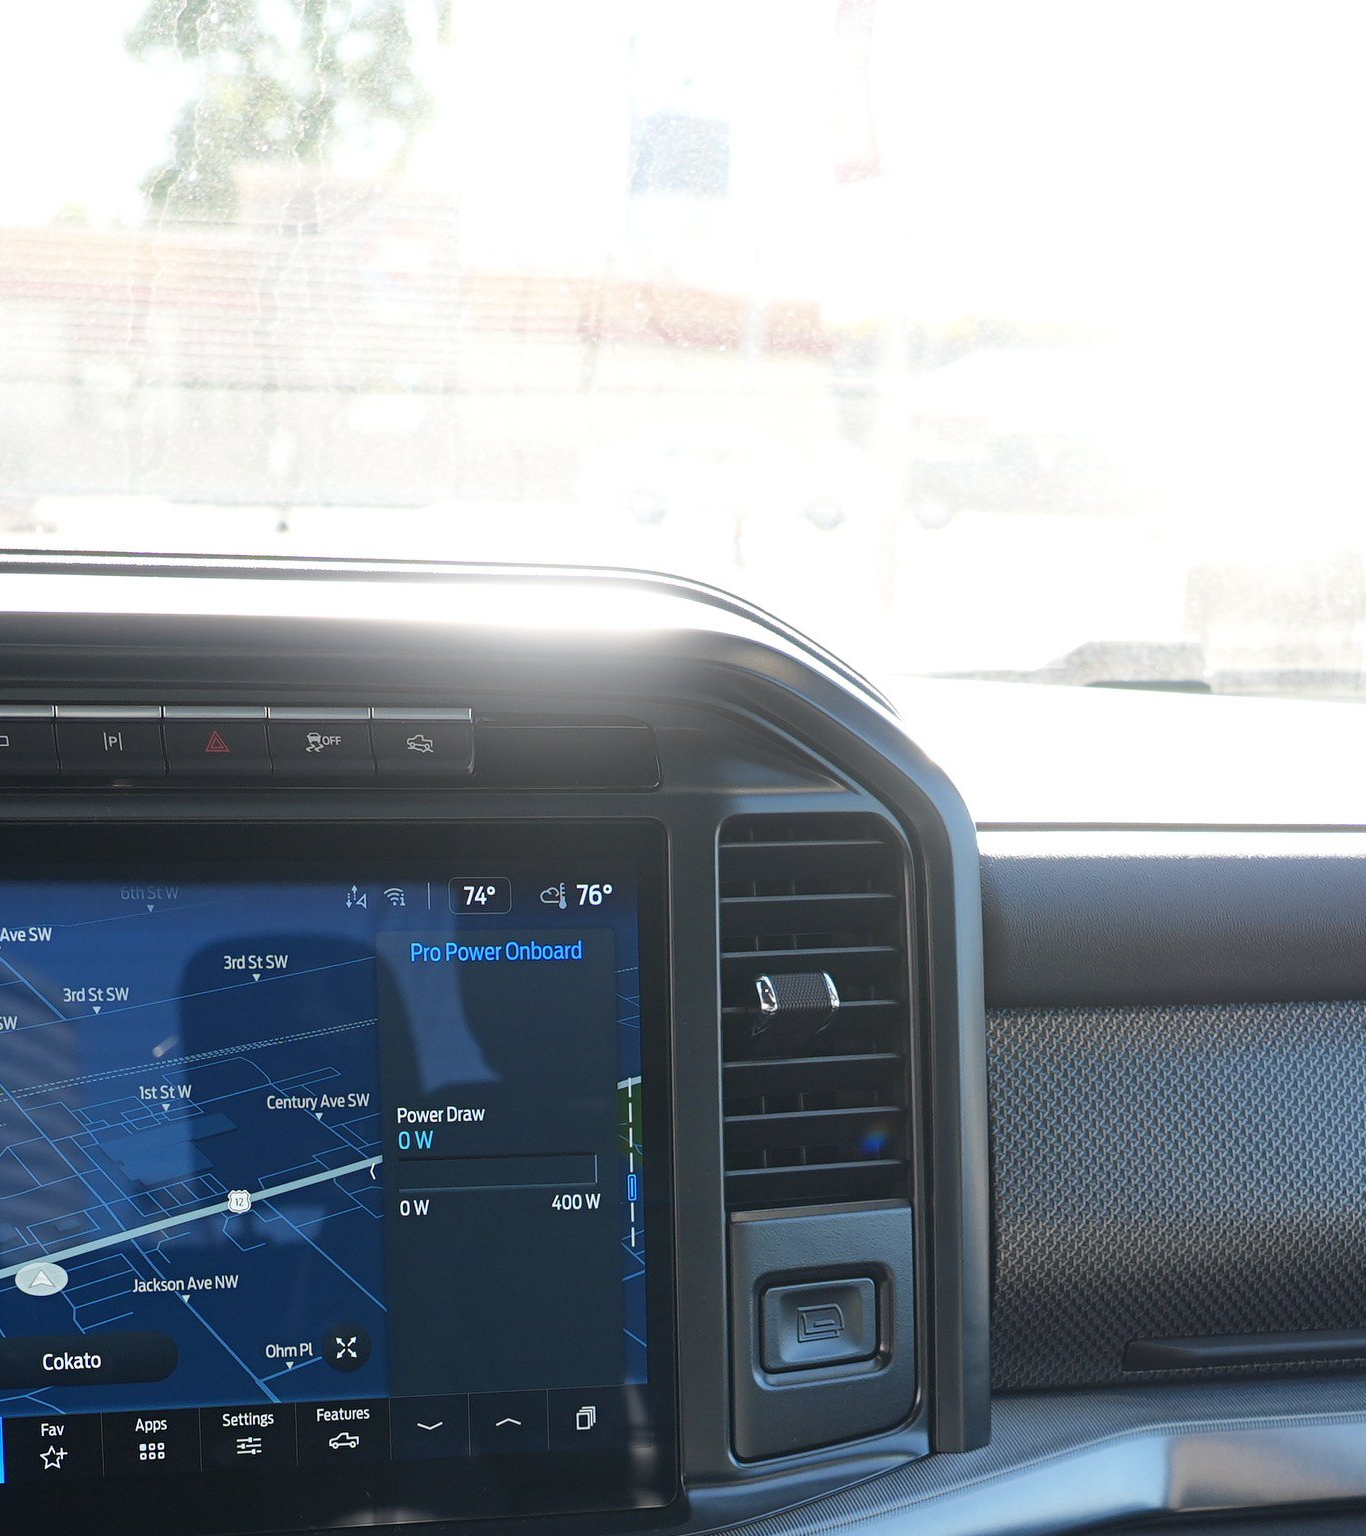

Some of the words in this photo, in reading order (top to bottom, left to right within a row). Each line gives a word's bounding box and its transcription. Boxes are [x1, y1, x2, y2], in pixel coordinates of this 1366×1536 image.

[322, 734, 341, 748] OFF
[121, 887, 144, 900] 6th
[148, 886, 161, 900] St
[166, 887, 178, 899] W
[464, 886, 495, 905] 74°
[577, 884, 612, 906] 76°
[0, 927, 26, 942] Ave
[28, 927, 52, 942] SW
[410, 943, 441, 962] Pro
[446, 942, 501, 962] Power
[506, 941, 583, 960] Onboard
[224, 956, 244, 970] 3rd
[248, 956, 263, 969] St
[266, 955, 288, 969] SW
[63, 988, 84, 1002] 3rd
[87, 988, 103, 1002] St
[105, 988, 129, 1001] SW
[139, 1086, 157, 1100] 1st
[160, 1085, 175, 1099] St
[177, 1085, 192, 1098] W
[266, 1094, 317, 1110] Century
[320, 1094, 345, 1108] Ave
[348, 1093, 370, 1107] SW
[397, 1107, 443, 1123] Power
[447, 1106, 485, 1122] Draw
[398, 1131, 410, 1150] 0
[415, 1130, 433, 1149] W
[235, 1196, 245, 1208] 12
[400, 1201, 410, 1217] 0
[413, 1200, 429, 1215] W
[552, 1195, 581, 1210] 400
[584, 1194, 601, 1209] W
[133, 1278, 185, 1294] Jackson
[188, 1277, 212, 1292] Ave
[214, 1275, 239, 1291] NW
[265, 1344, 296, 1359] Ohm
[42, 1354, 102, 1371] Cokato
[222, 1412, 274, 1429] Settings
[316, 1407, 370, 1422] Features
[41, 1423, 64, 1437] Fav
[135, 1418, 167, 1434] Apps
